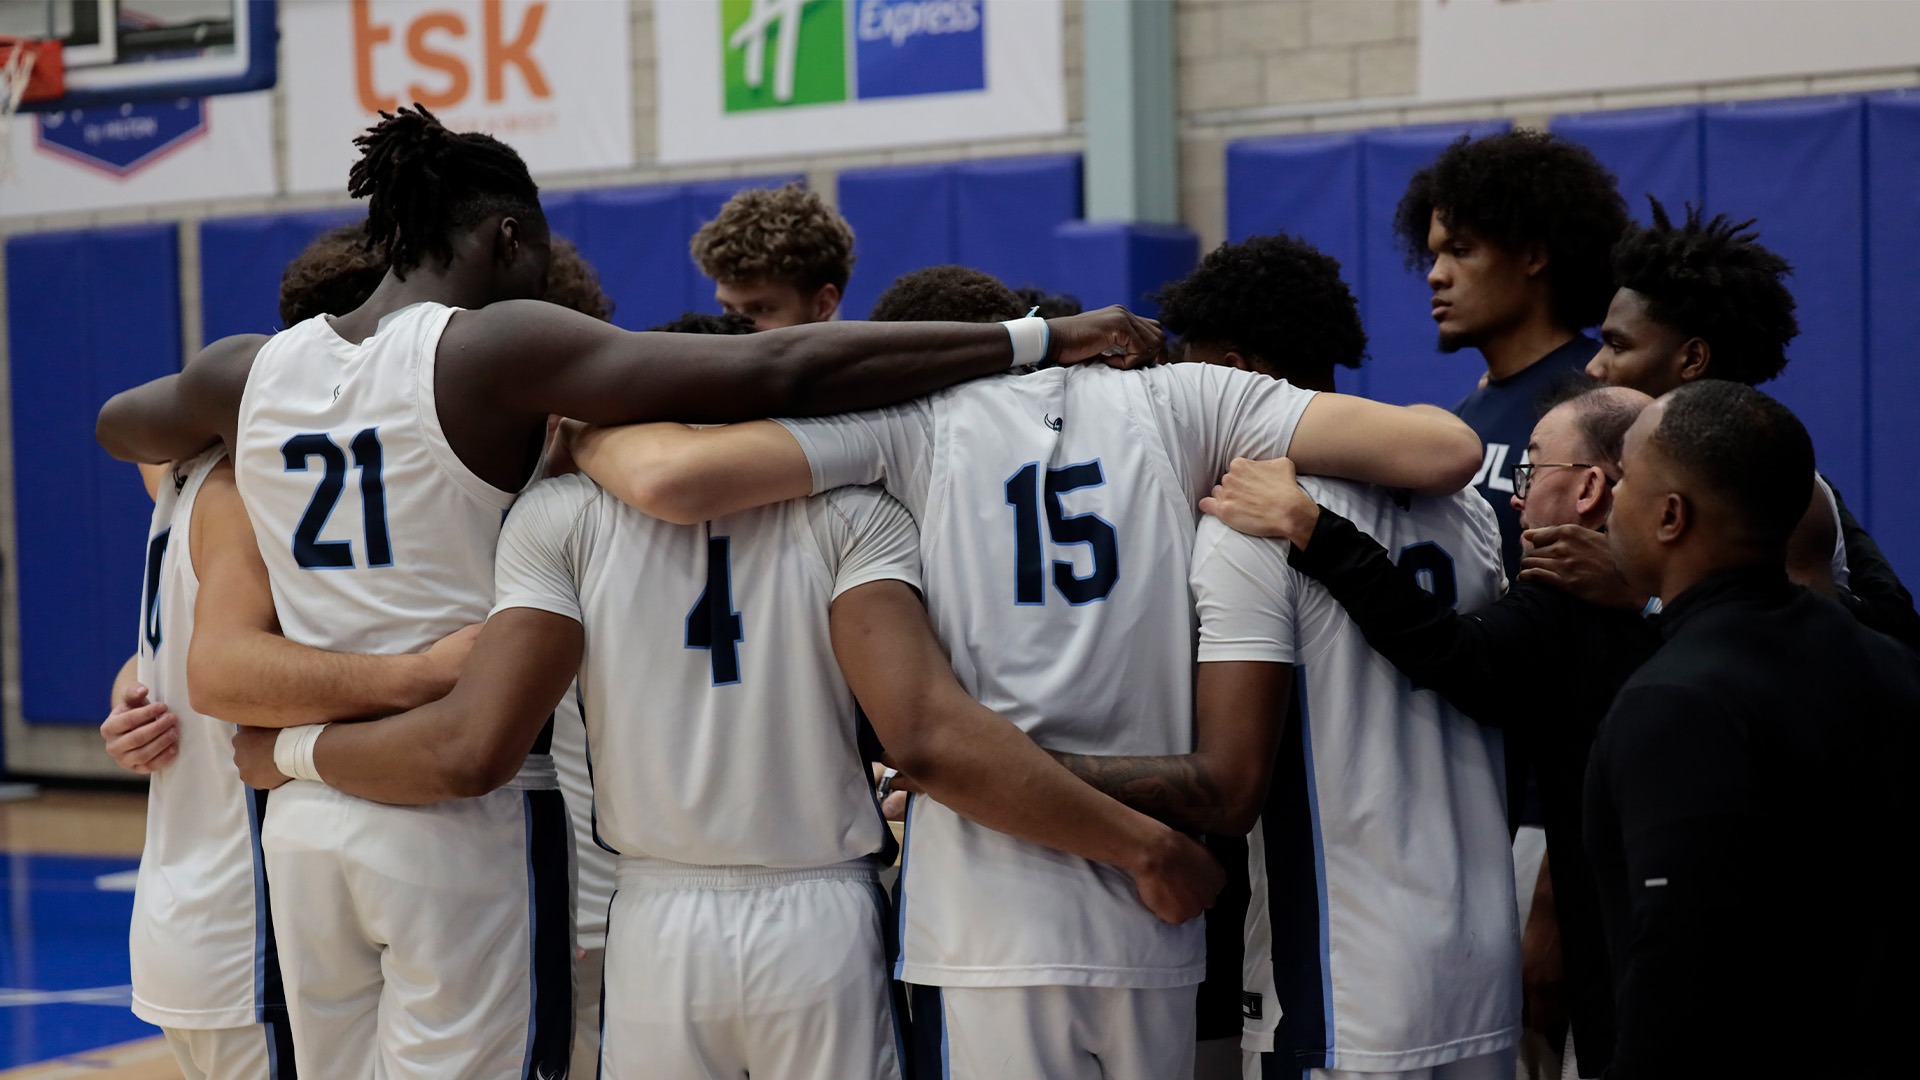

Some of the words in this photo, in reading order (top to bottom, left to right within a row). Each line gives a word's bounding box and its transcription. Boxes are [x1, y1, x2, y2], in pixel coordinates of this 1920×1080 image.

[351, 0, 553, 116] tsk
[858, 0, 979, 47] Express
[280, 426, 394, 570] 21
[1004, 457, 1120, 606] 15
[683, 535, 745, 687] 4
